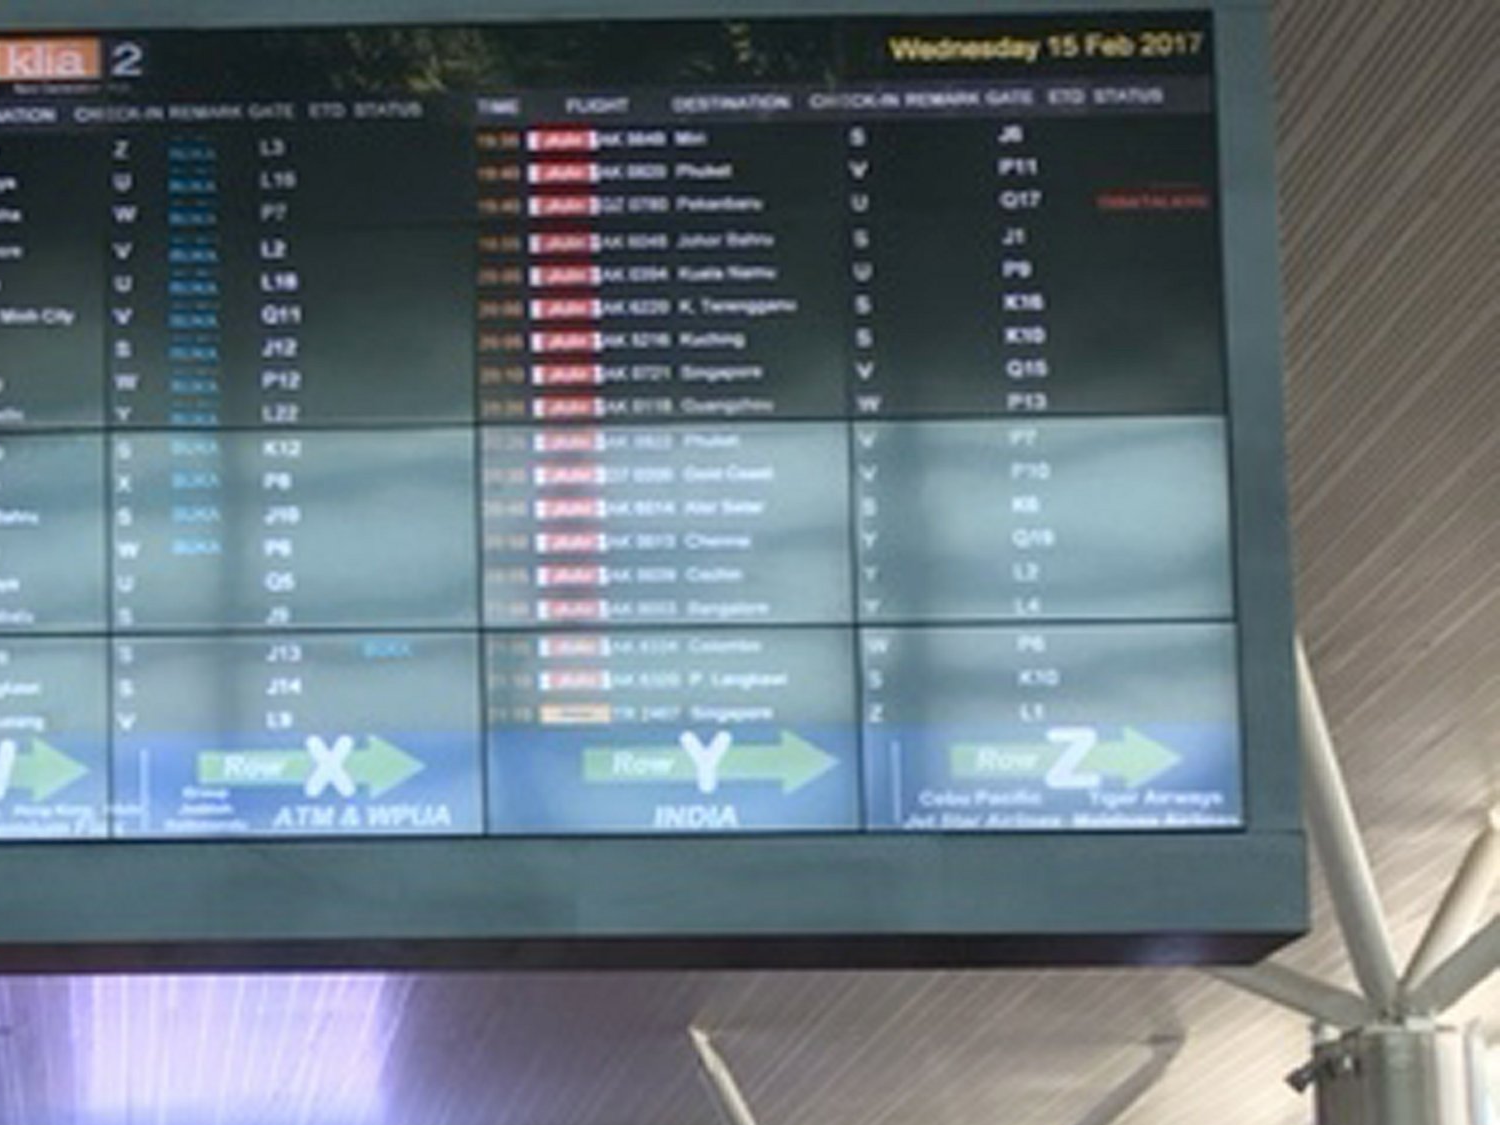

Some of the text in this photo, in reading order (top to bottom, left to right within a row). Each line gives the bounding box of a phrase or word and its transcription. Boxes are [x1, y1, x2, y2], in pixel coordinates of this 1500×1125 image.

[112, 42, 143, 76] 2
[889, 32, 1202, 61] Wednesday 15 Feb 2017
[168, 105, 243, 120] REMARK
[249, 104, 295, 119] GATE
[354, 103, 424, 119] STATUS
[566, 97, 629, 113] FLIGHT
[672, 95, 791, 112] DESTINATION
[905, 91, 980, 107] REMARK
[986, 90, 1032, 105] GATE
[1094, 87, 1164, 103] STATUS
[225, 735, 356, 798] Row X
[613, 731, 732, 793] Row Y
[975, 727, 1100, 789] Row Z
[276, 804, 334, 828] ATM
[653, 805, 739, 828] INDIA
